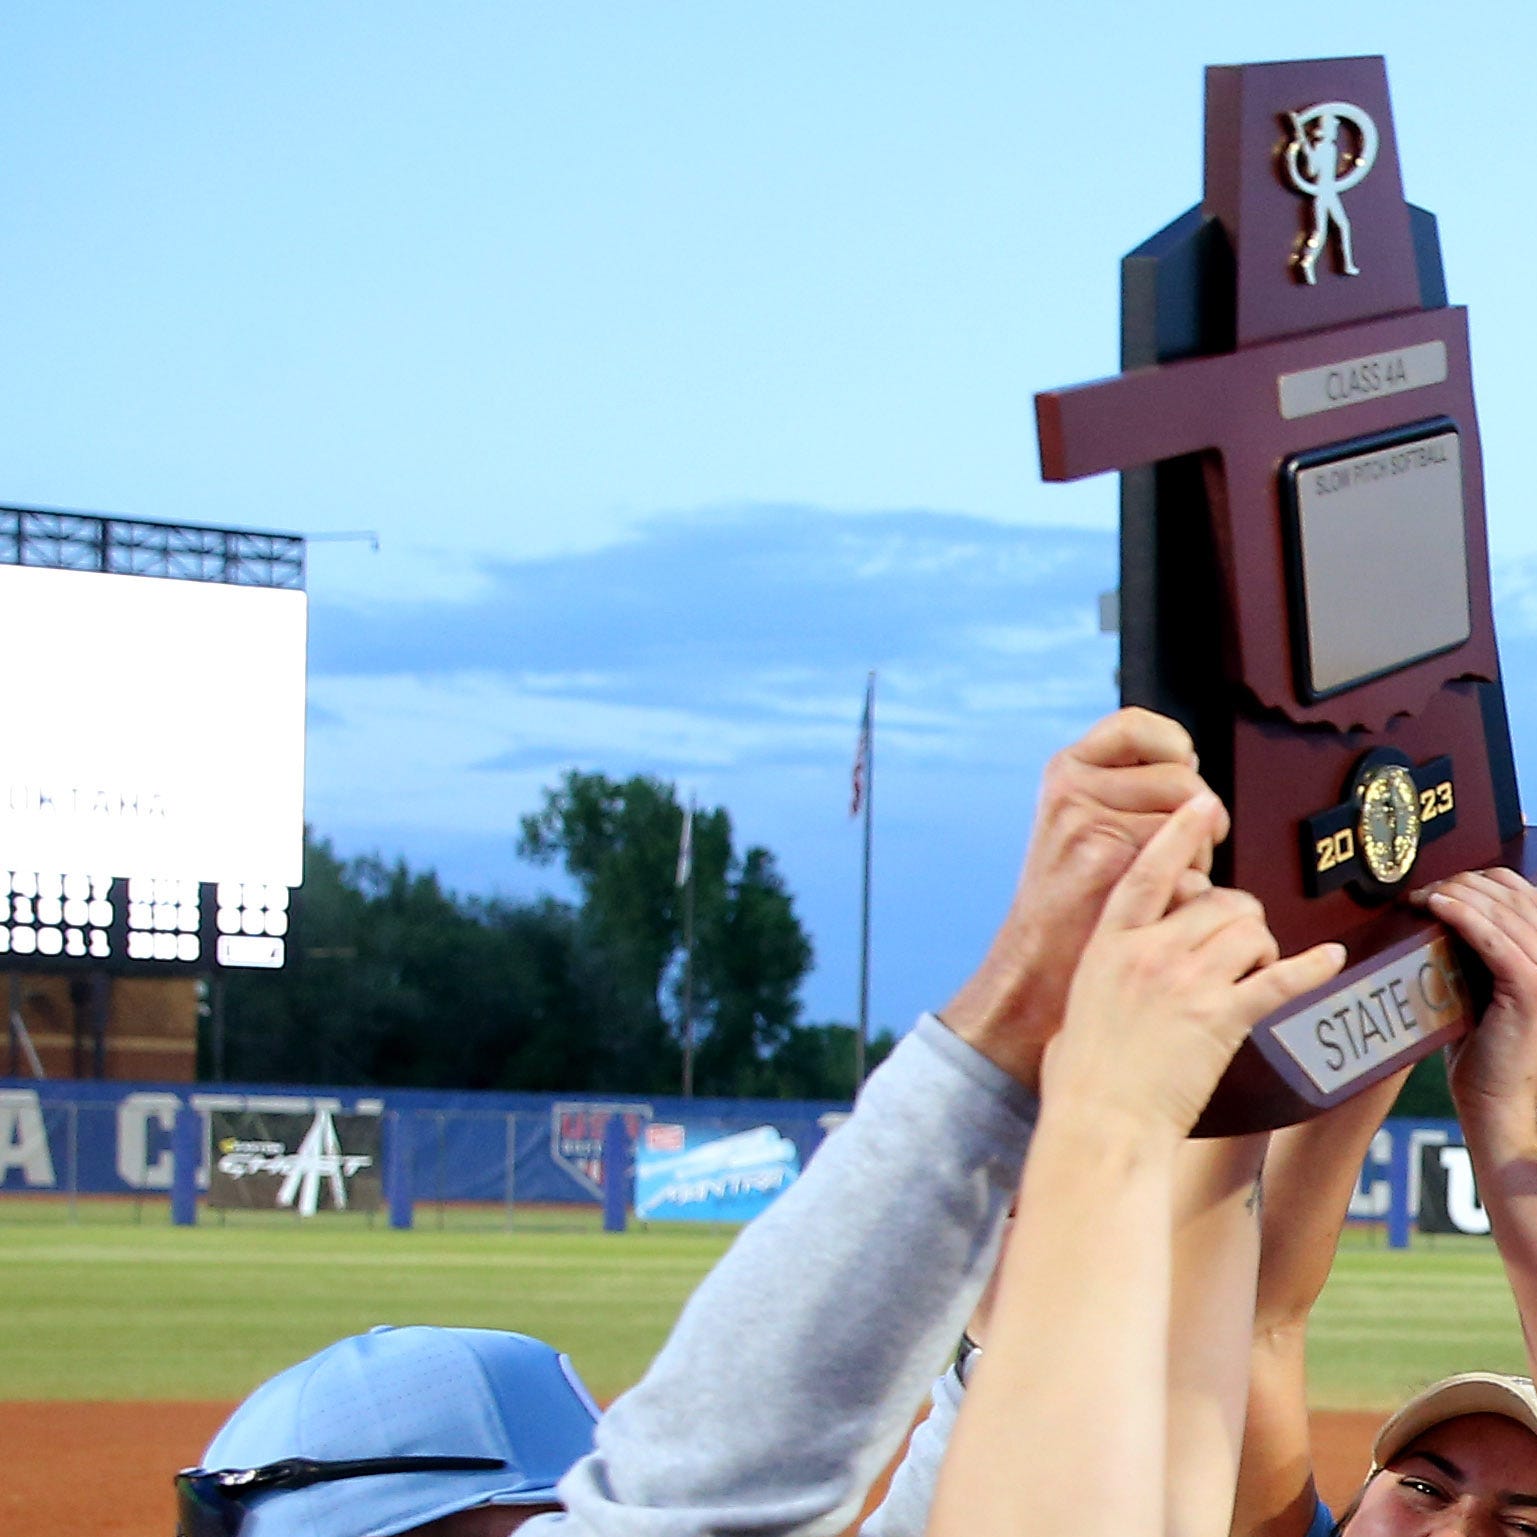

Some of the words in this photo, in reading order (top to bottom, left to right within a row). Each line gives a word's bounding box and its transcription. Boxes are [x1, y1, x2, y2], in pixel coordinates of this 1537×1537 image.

[1326, 362, 1382, 401] CLASS
[1386, 358, 1407, 386] 4A
[1420, 780, 1454, 823] 23
[1316, 828, 1355, 872] 20
[1315, 978, 1417, 1073] STATE
